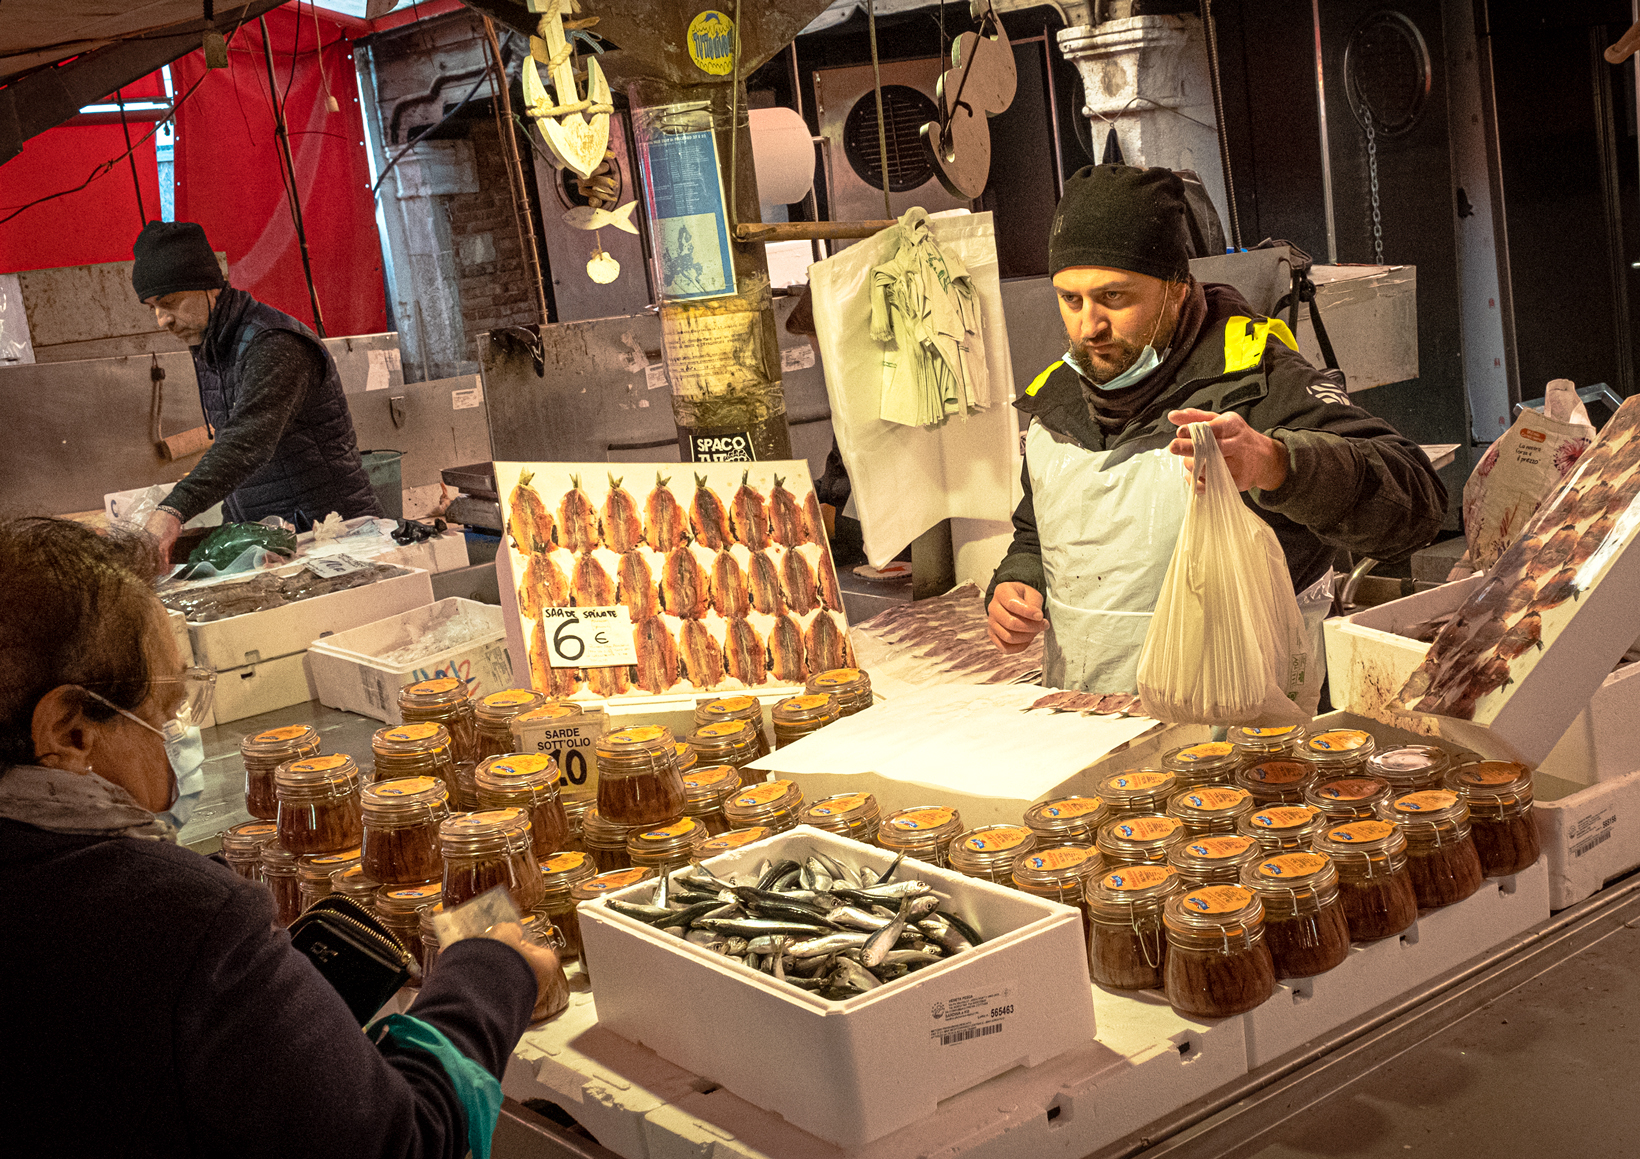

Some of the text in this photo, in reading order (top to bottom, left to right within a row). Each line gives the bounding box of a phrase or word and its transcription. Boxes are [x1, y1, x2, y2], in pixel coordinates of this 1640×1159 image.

[697, 436, 746, 452] SPACO
[553, 618, 609, 661] 6 €
[545, 727, 580, 739] SARDE
[537, 737, 591, 751] SOTT'OLIO
